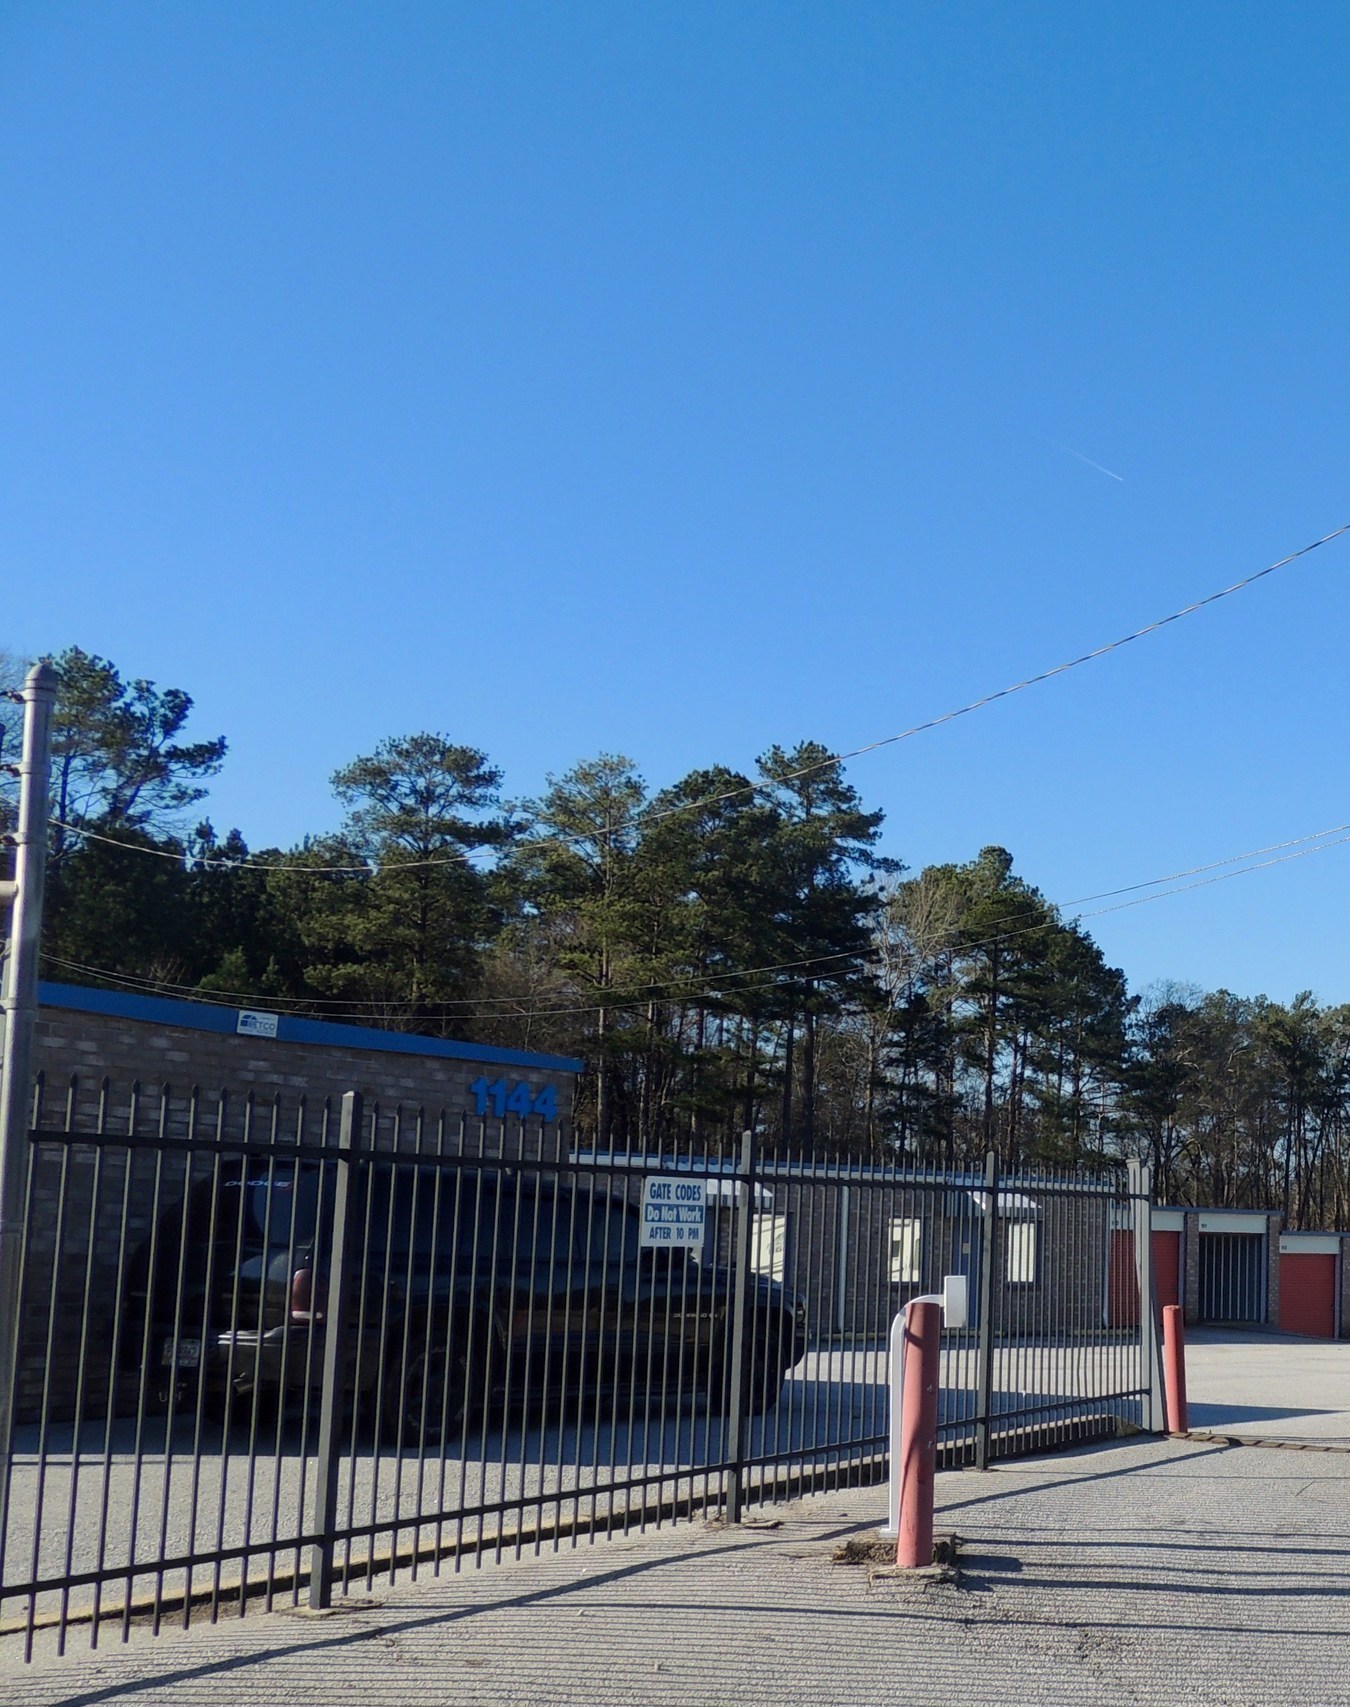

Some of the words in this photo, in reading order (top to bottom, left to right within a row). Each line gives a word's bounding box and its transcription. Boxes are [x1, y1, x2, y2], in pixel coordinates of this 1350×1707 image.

[470, 1076, 558, 1123] 1144
[650, 1182, 671, 1200] GATE
[675, 1183, 701, 1201] CODES
[647, 1205, 659, 1220] Do
[661, 1206, 677, 1221] Not
[680, 1206, 701, 1222] Work
[649, 1227, 671, 1239] AFTER
[676, 1227, 684, 1239] 10
[688, 1227, 699, 1240] PM
